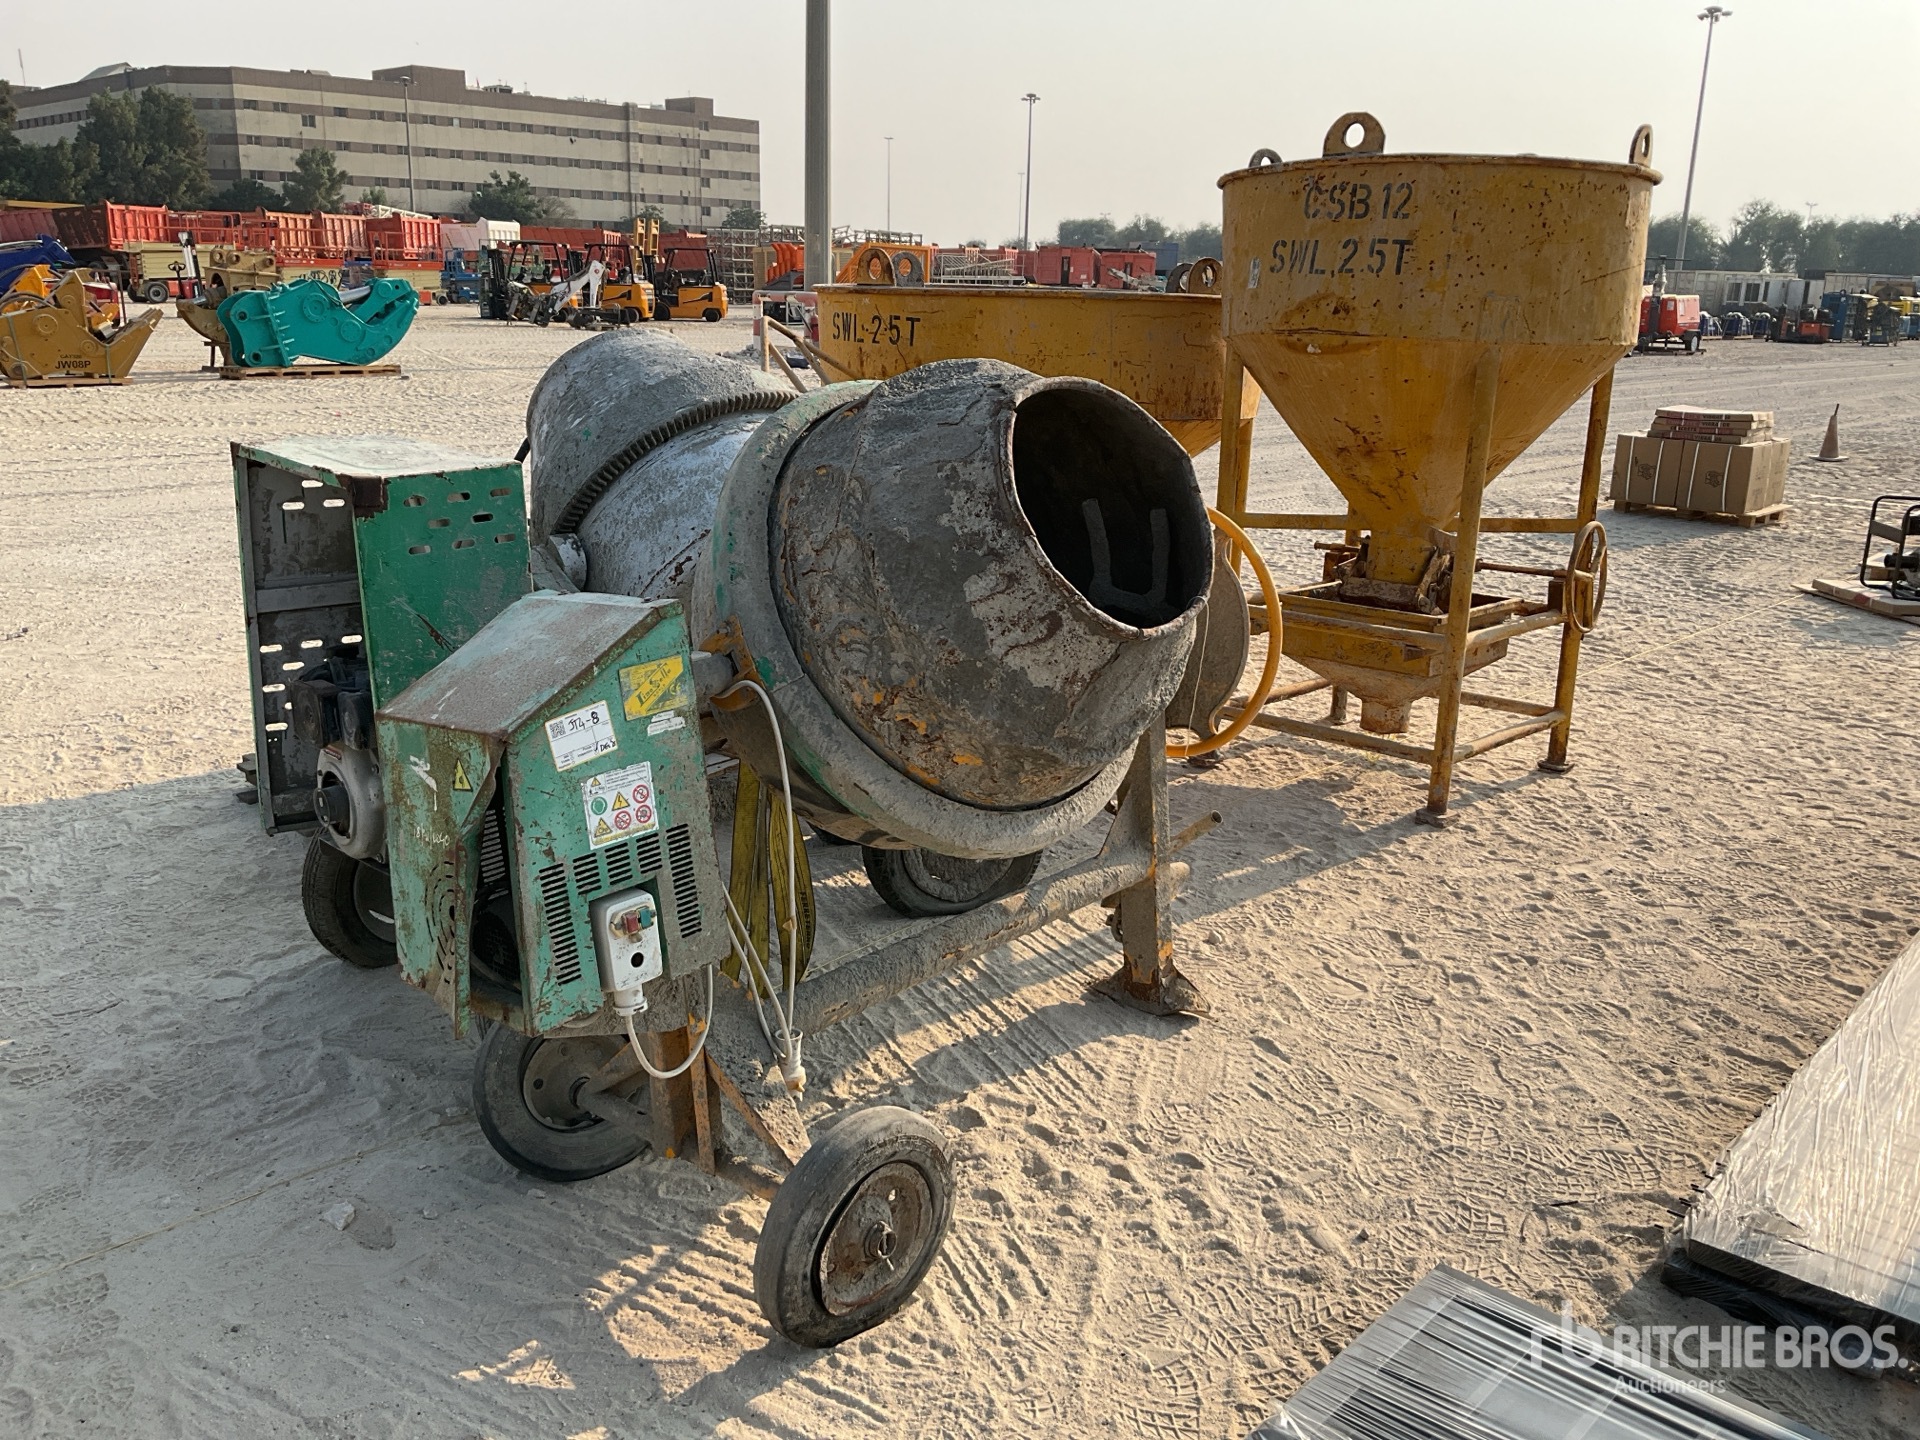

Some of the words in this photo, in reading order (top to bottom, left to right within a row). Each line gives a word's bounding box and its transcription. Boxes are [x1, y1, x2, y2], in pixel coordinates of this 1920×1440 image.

[1304, 182, 1372, 220] CSB
[1382, 182, 1413, 220] 12
[55, 360, 91, 369] JW08P
